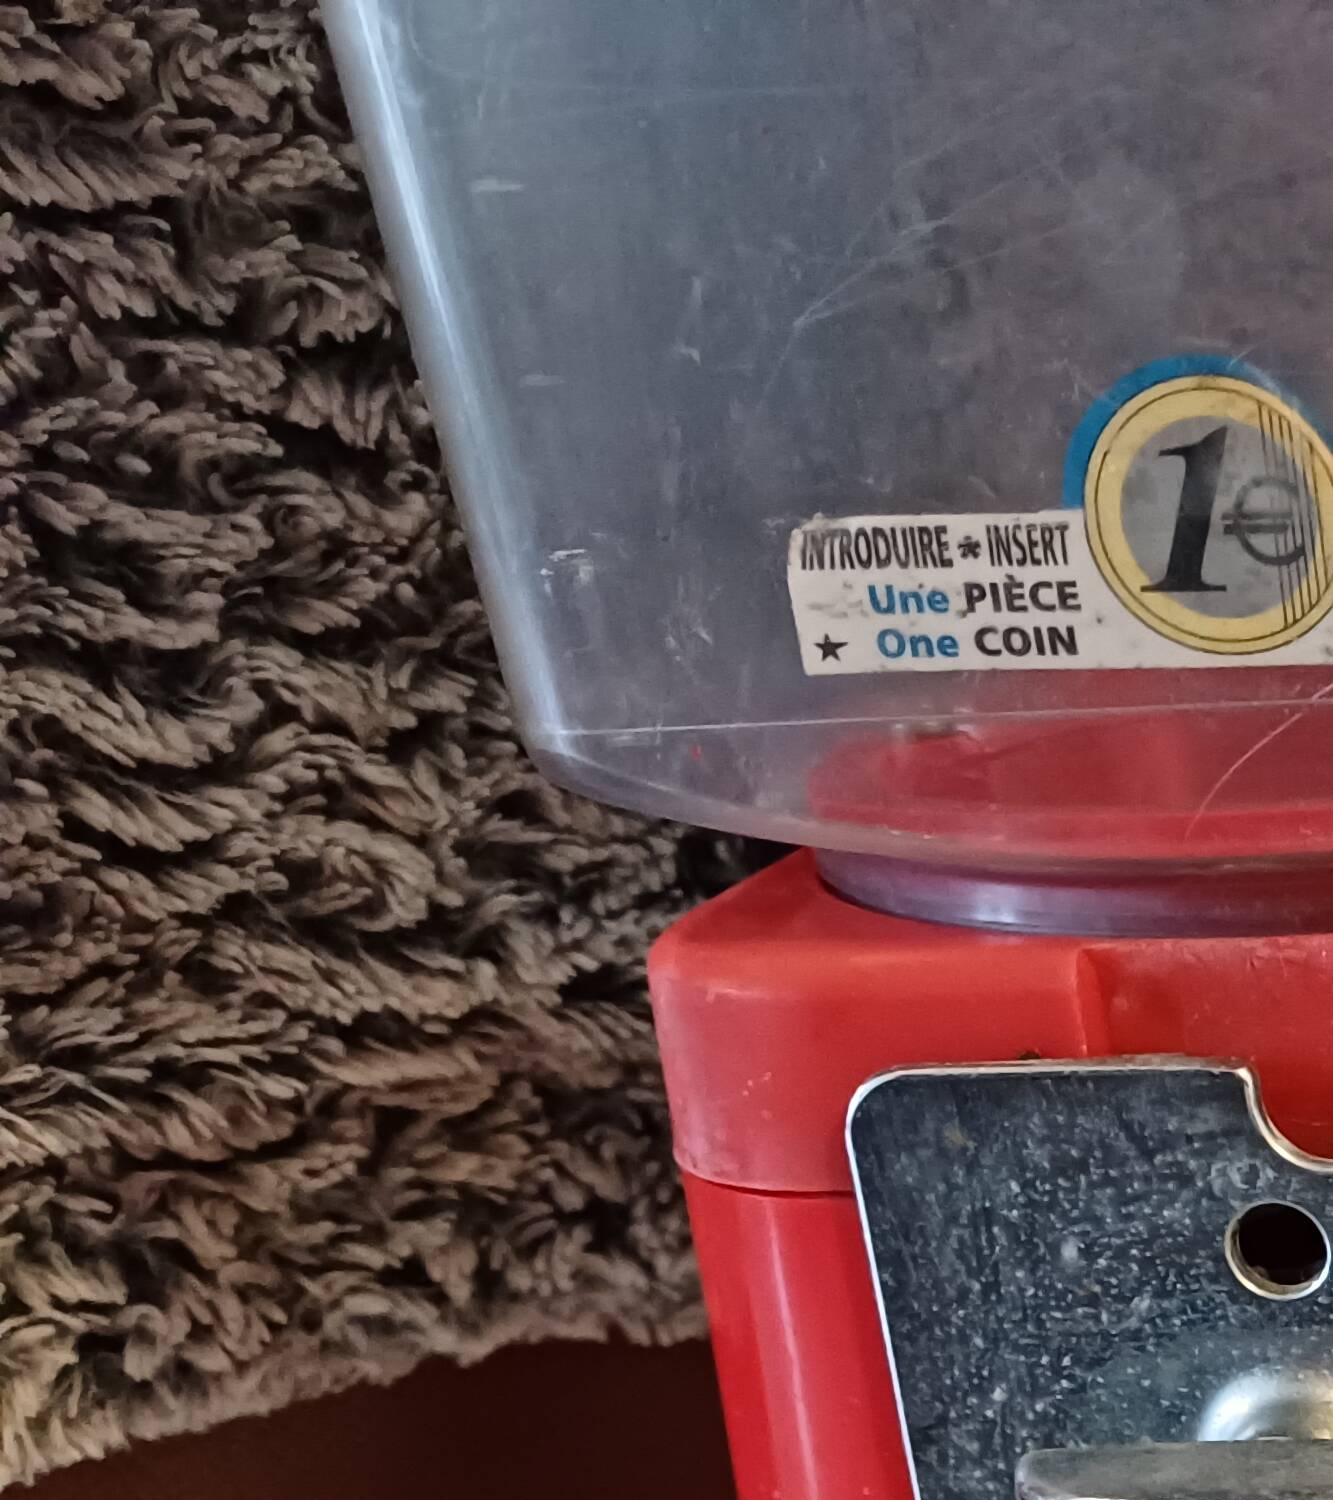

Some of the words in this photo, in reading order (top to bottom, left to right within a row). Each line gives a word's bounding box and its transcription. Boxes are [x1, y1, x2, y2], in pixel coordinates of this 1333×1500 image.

[800, 525, 953, 572] INTRODUIRE
[984, 523, 1070, 567] INSERT
[868, 584, 950, 616] Une
[964, 574, 1082, 613] PIÈCE
[876, 630, 960, 660] One
[974, 626, 1079, 657] COIN
